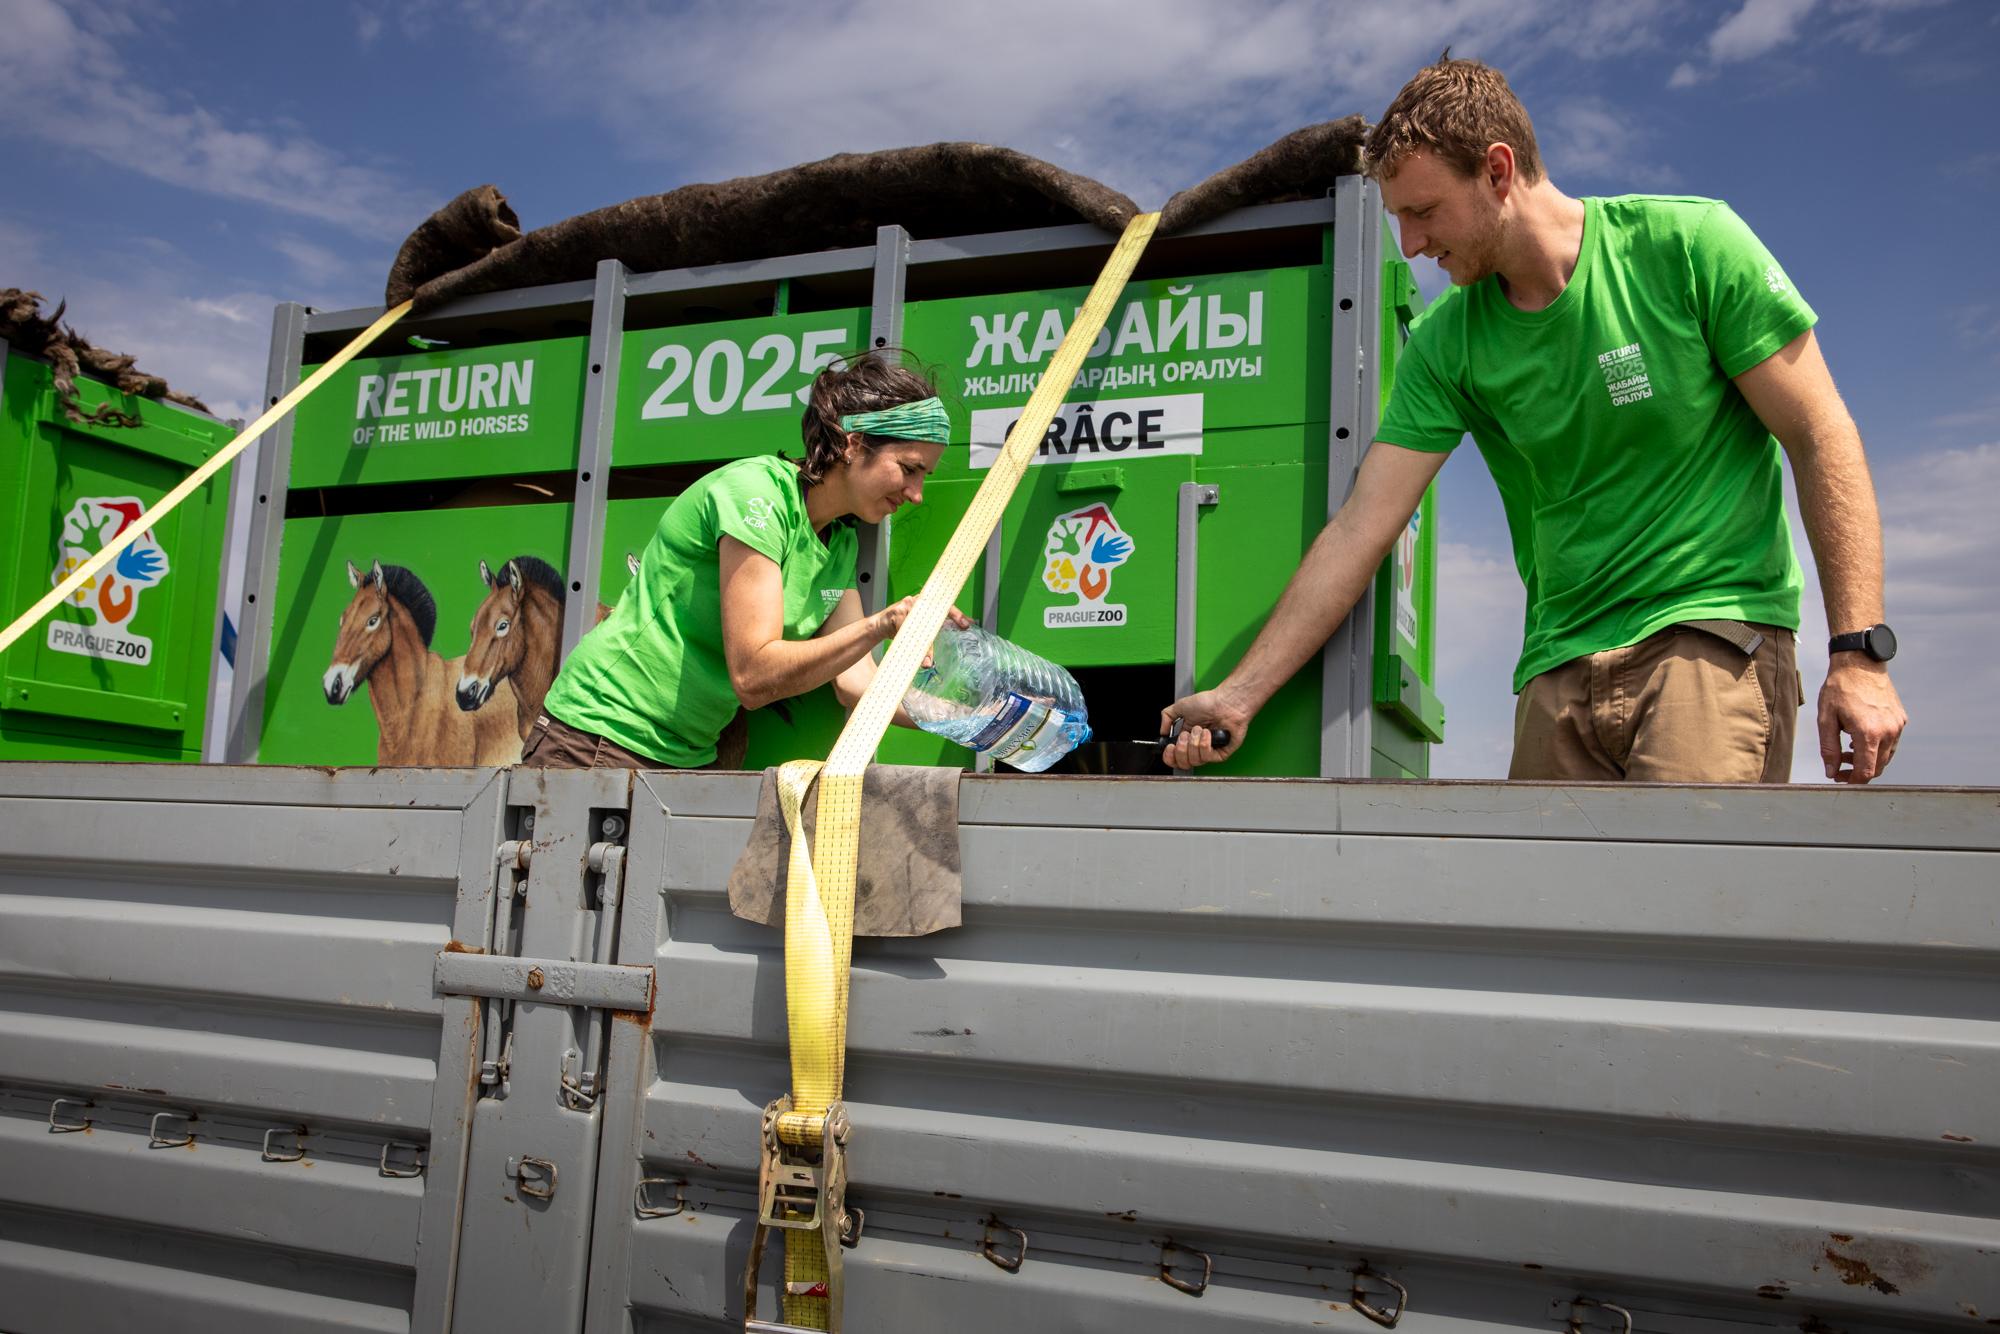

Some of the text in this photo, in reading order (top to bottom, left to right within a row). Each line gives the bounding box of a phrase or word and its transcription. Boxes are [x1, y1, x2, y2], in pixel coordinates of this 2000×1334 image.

[1598, 343, 1640, 364] RETURN
[1163, 356, 1262, 383] ОРАЛУЫ
[1603, 357, 1646, 383] 2025
[1608, 373, 1648, 392] ЖАБАЙЫ
[356, 359, 534, 419] RETURN
[1612, 388, 1653, 407] ОРАЛУЫ
[352, 413, 529, 445] OF THE WILD HORSES
